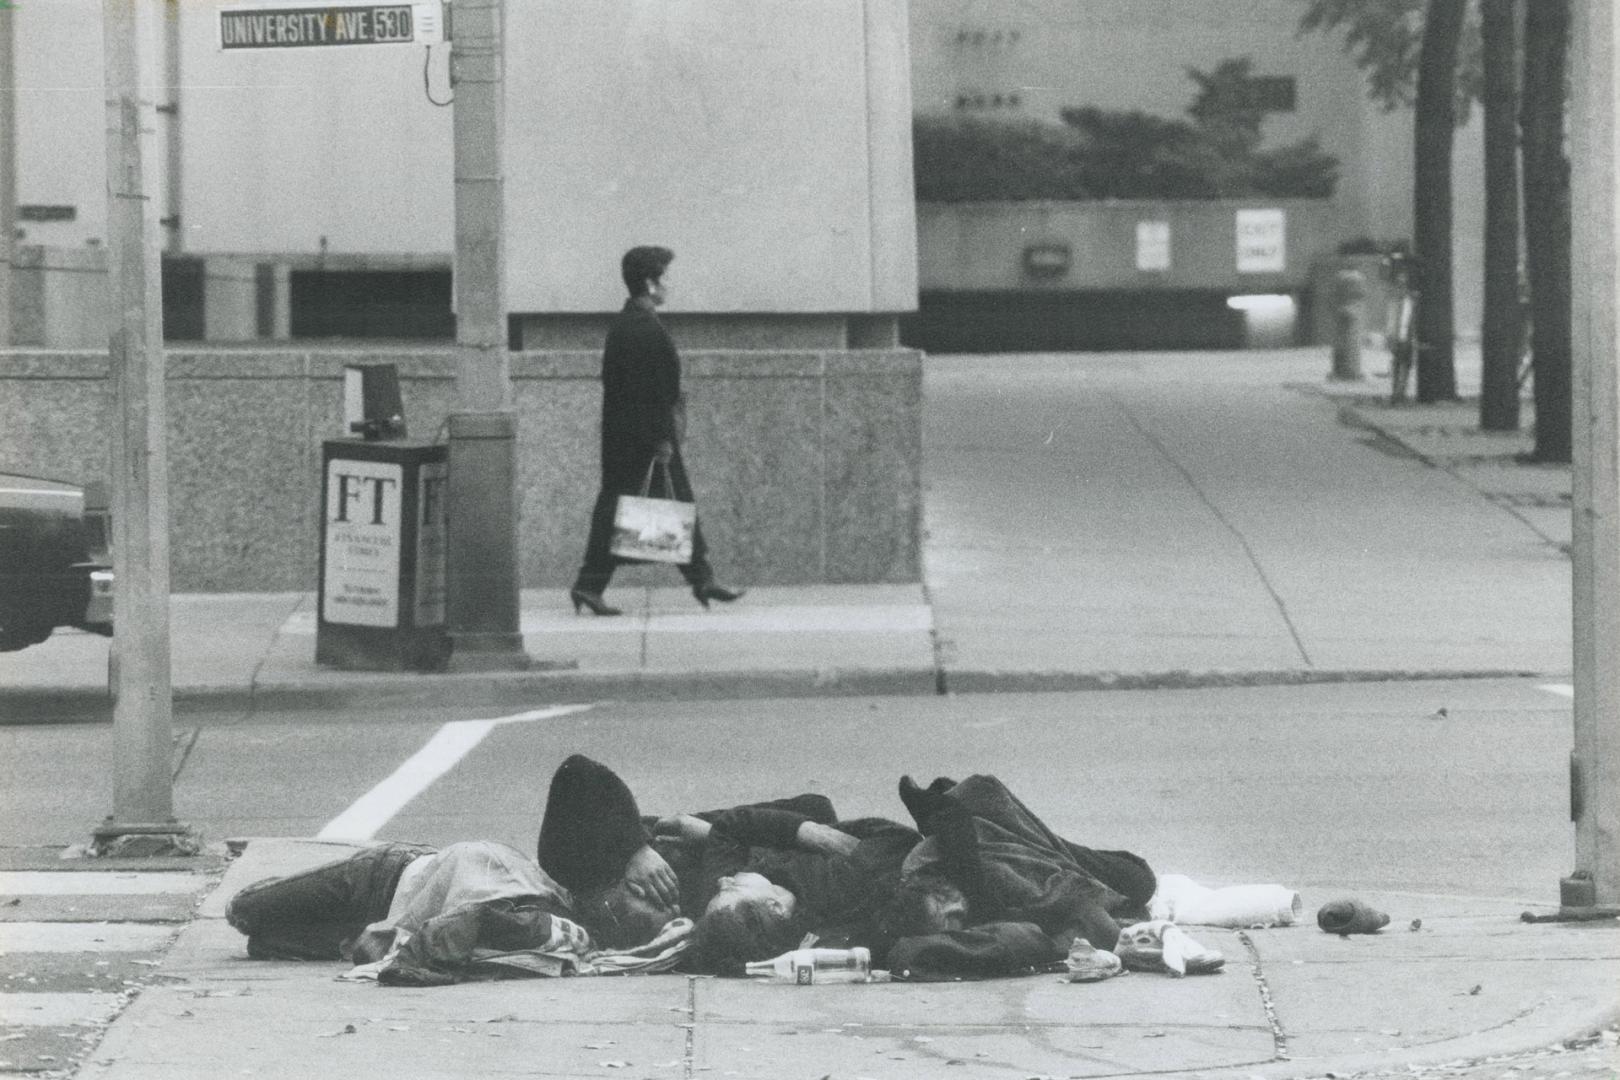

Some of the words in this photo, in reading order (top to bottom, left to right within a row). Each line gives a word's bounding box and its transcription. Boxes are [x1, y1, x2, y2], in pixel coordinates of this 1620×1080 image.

[222, 13, 328, 44] UNIVERSITY
[376, 10, 410, 39] 530
[334, 475, 396, 525] FT
